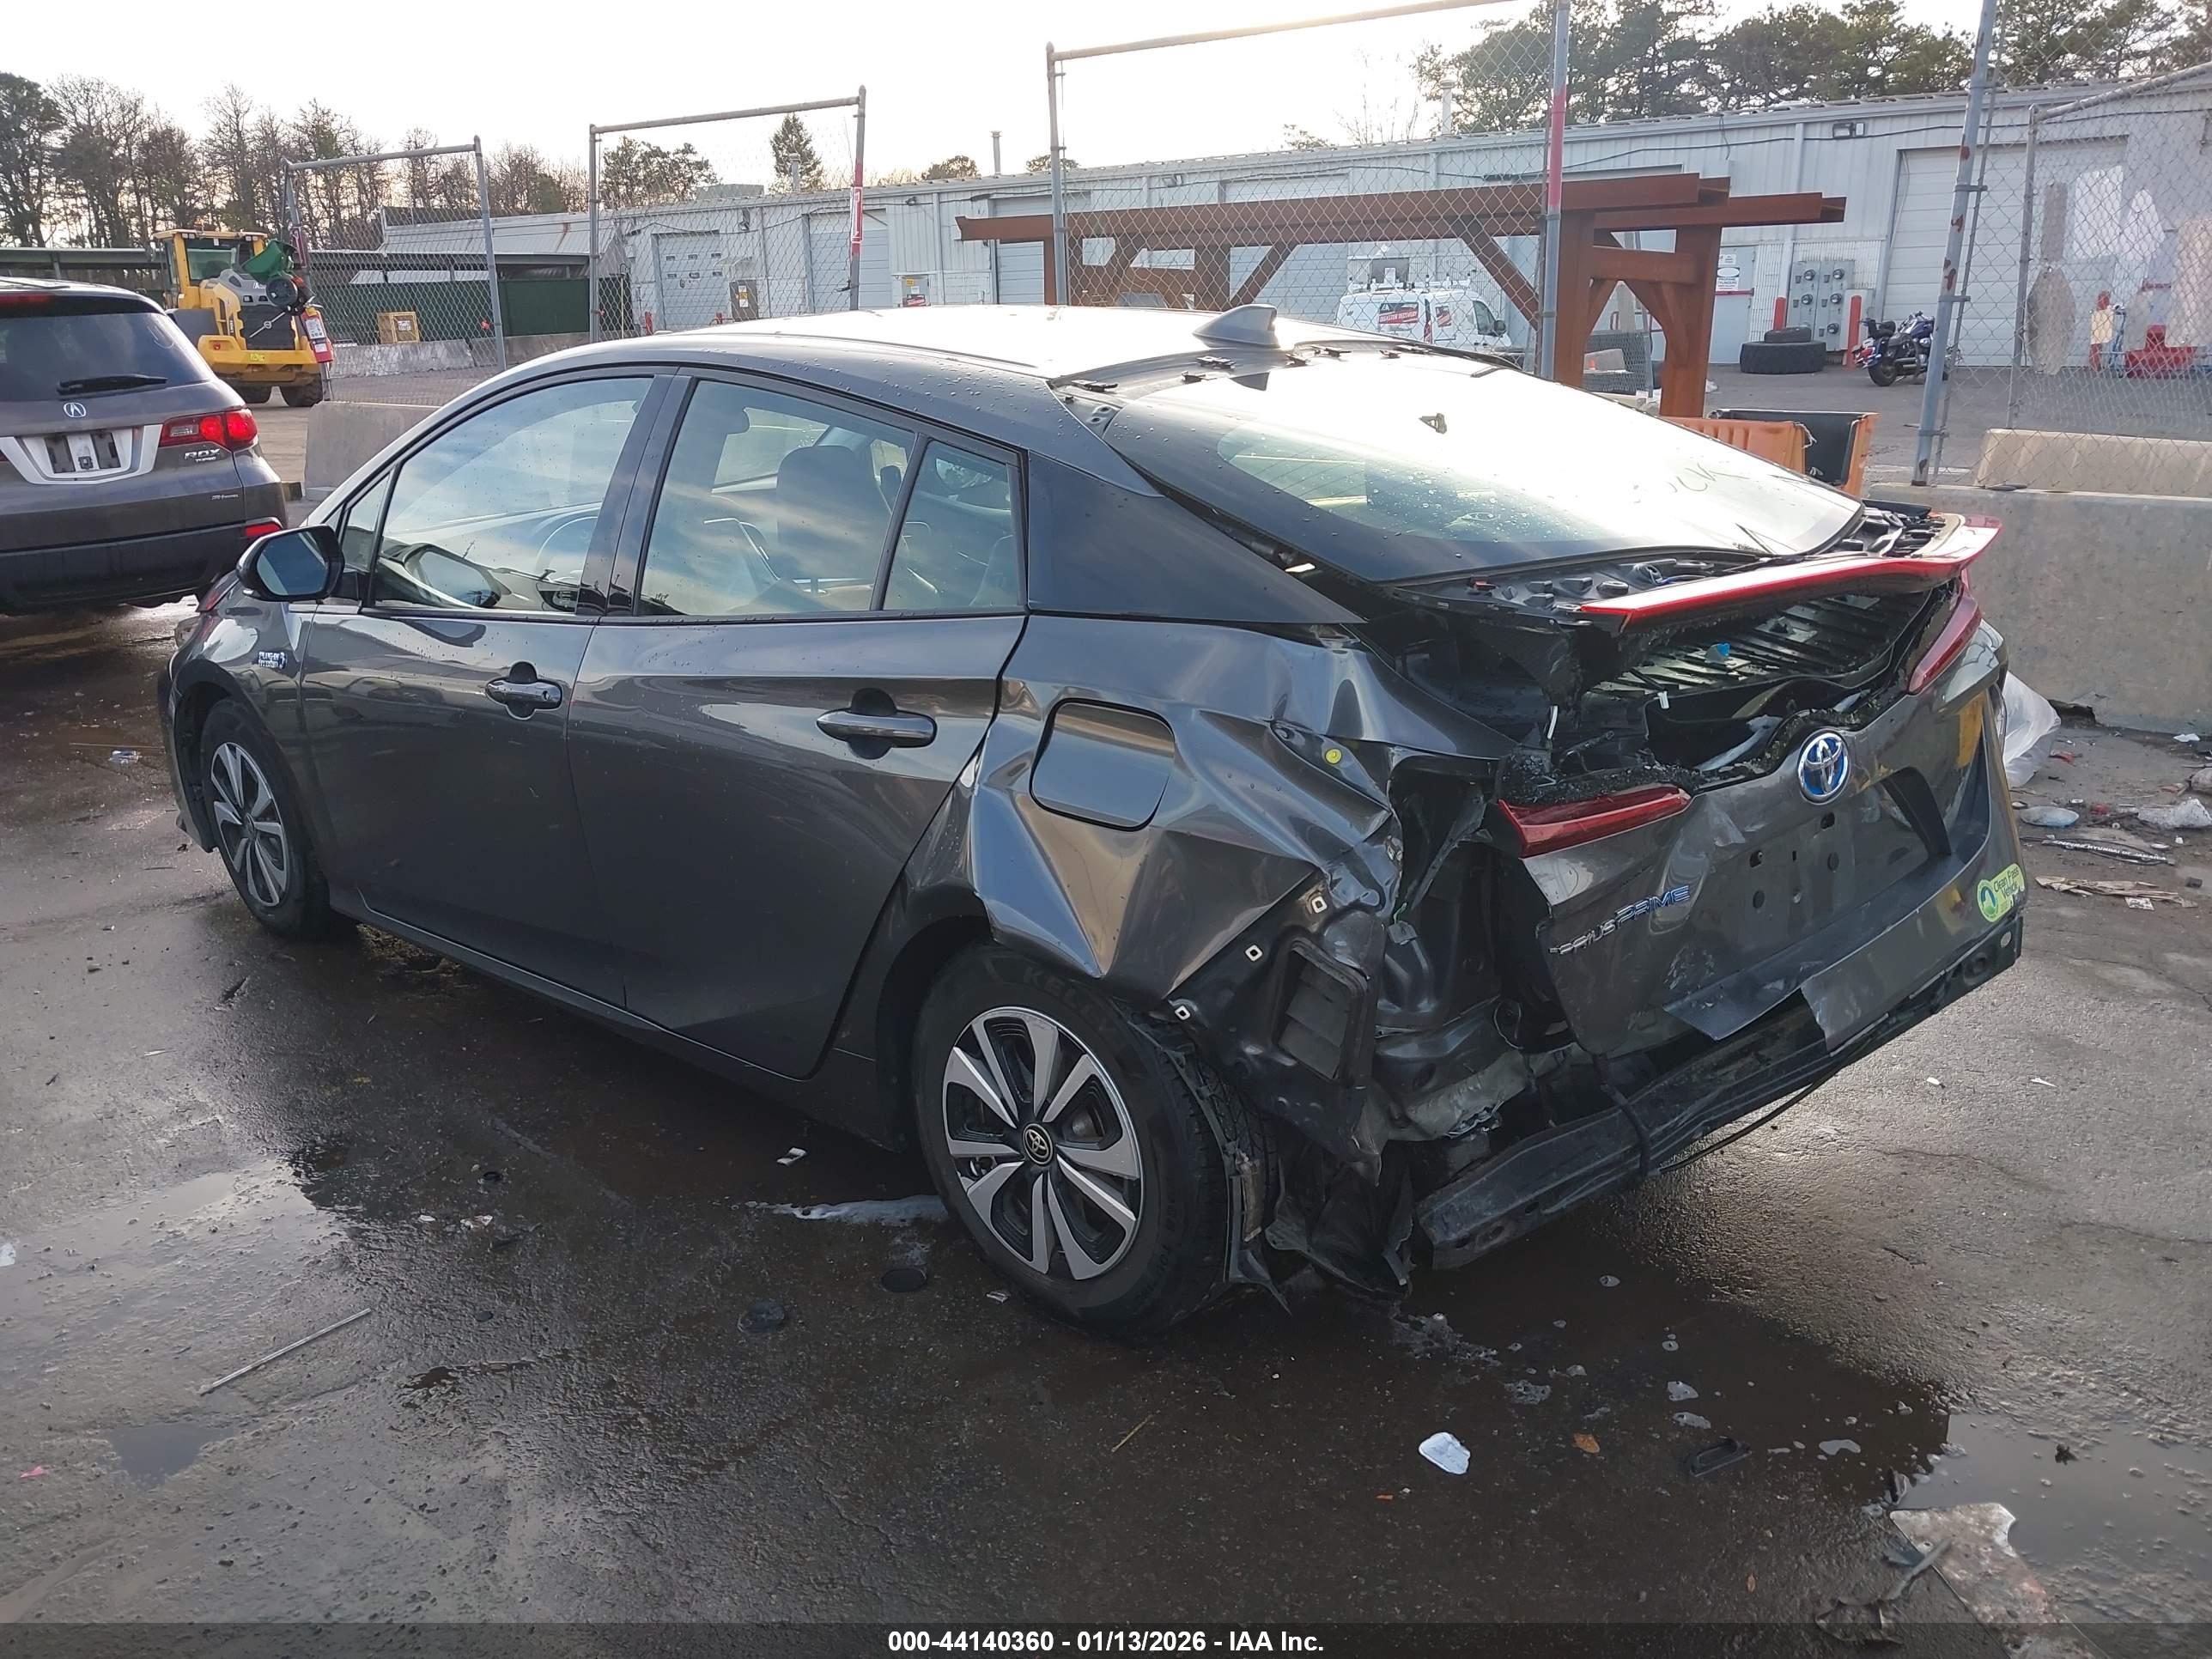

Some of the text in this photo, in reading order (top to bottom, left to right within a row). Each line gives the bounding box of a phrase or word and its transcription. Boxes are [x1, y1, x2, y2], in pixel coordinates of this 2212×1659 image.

[184, 448, 220, 460] RDX
[1994, 876, 2010, 892] Clean
[1615, 884, 1690, 929] PRIME
